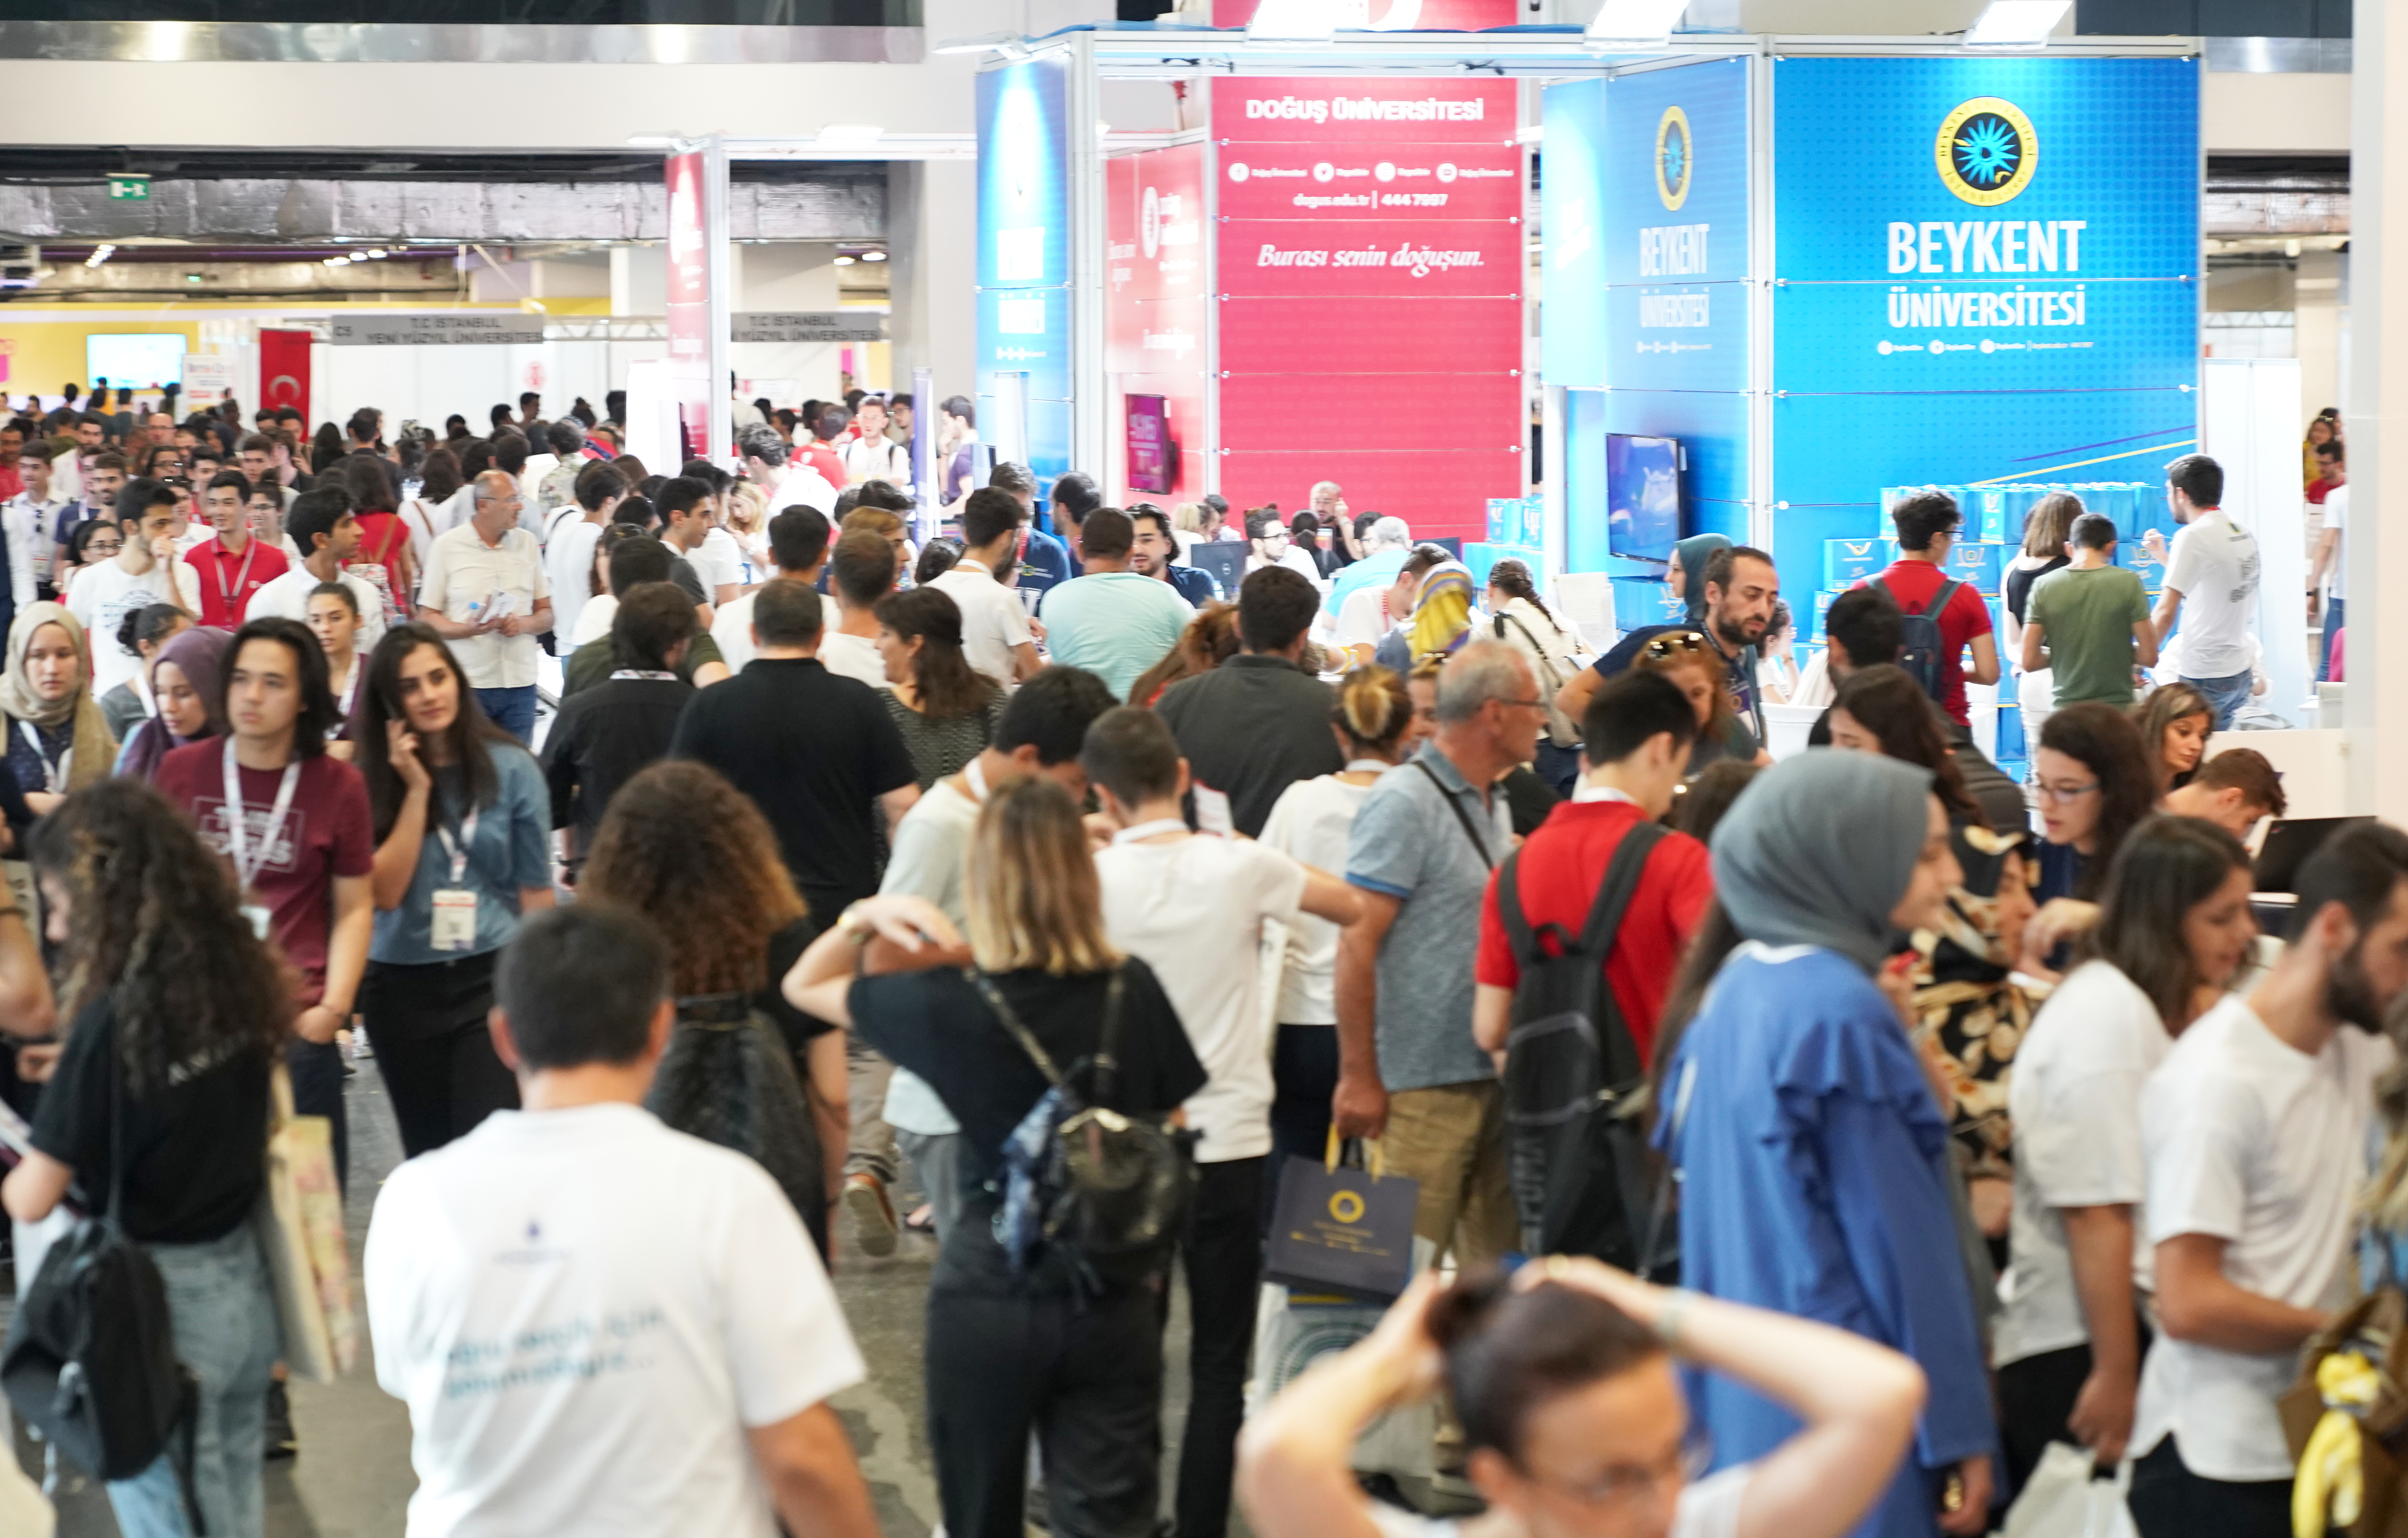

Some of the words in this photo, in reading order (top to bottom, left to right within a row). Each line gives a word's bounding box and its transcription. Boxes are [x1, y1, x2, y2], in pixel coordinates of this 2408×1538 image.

[1246, 96, 1329, 124] DOĞUŞ
[1332, 97, 1484, 121] ÜNİVERSİTESİ
[1380, 193, 1412, 206] 444
[1257, 244, 1329, 267] Burası
[1332, 244, 1388, 267] senin
[1390, 242, 1485, 278] doğuşun.
[1639, 223, 1710, 276] BEYKENT
[1887, 220, 2087, 274] BEYKENT
[1888, 284, 2085, 328] ÜNİVERSİTESİ
